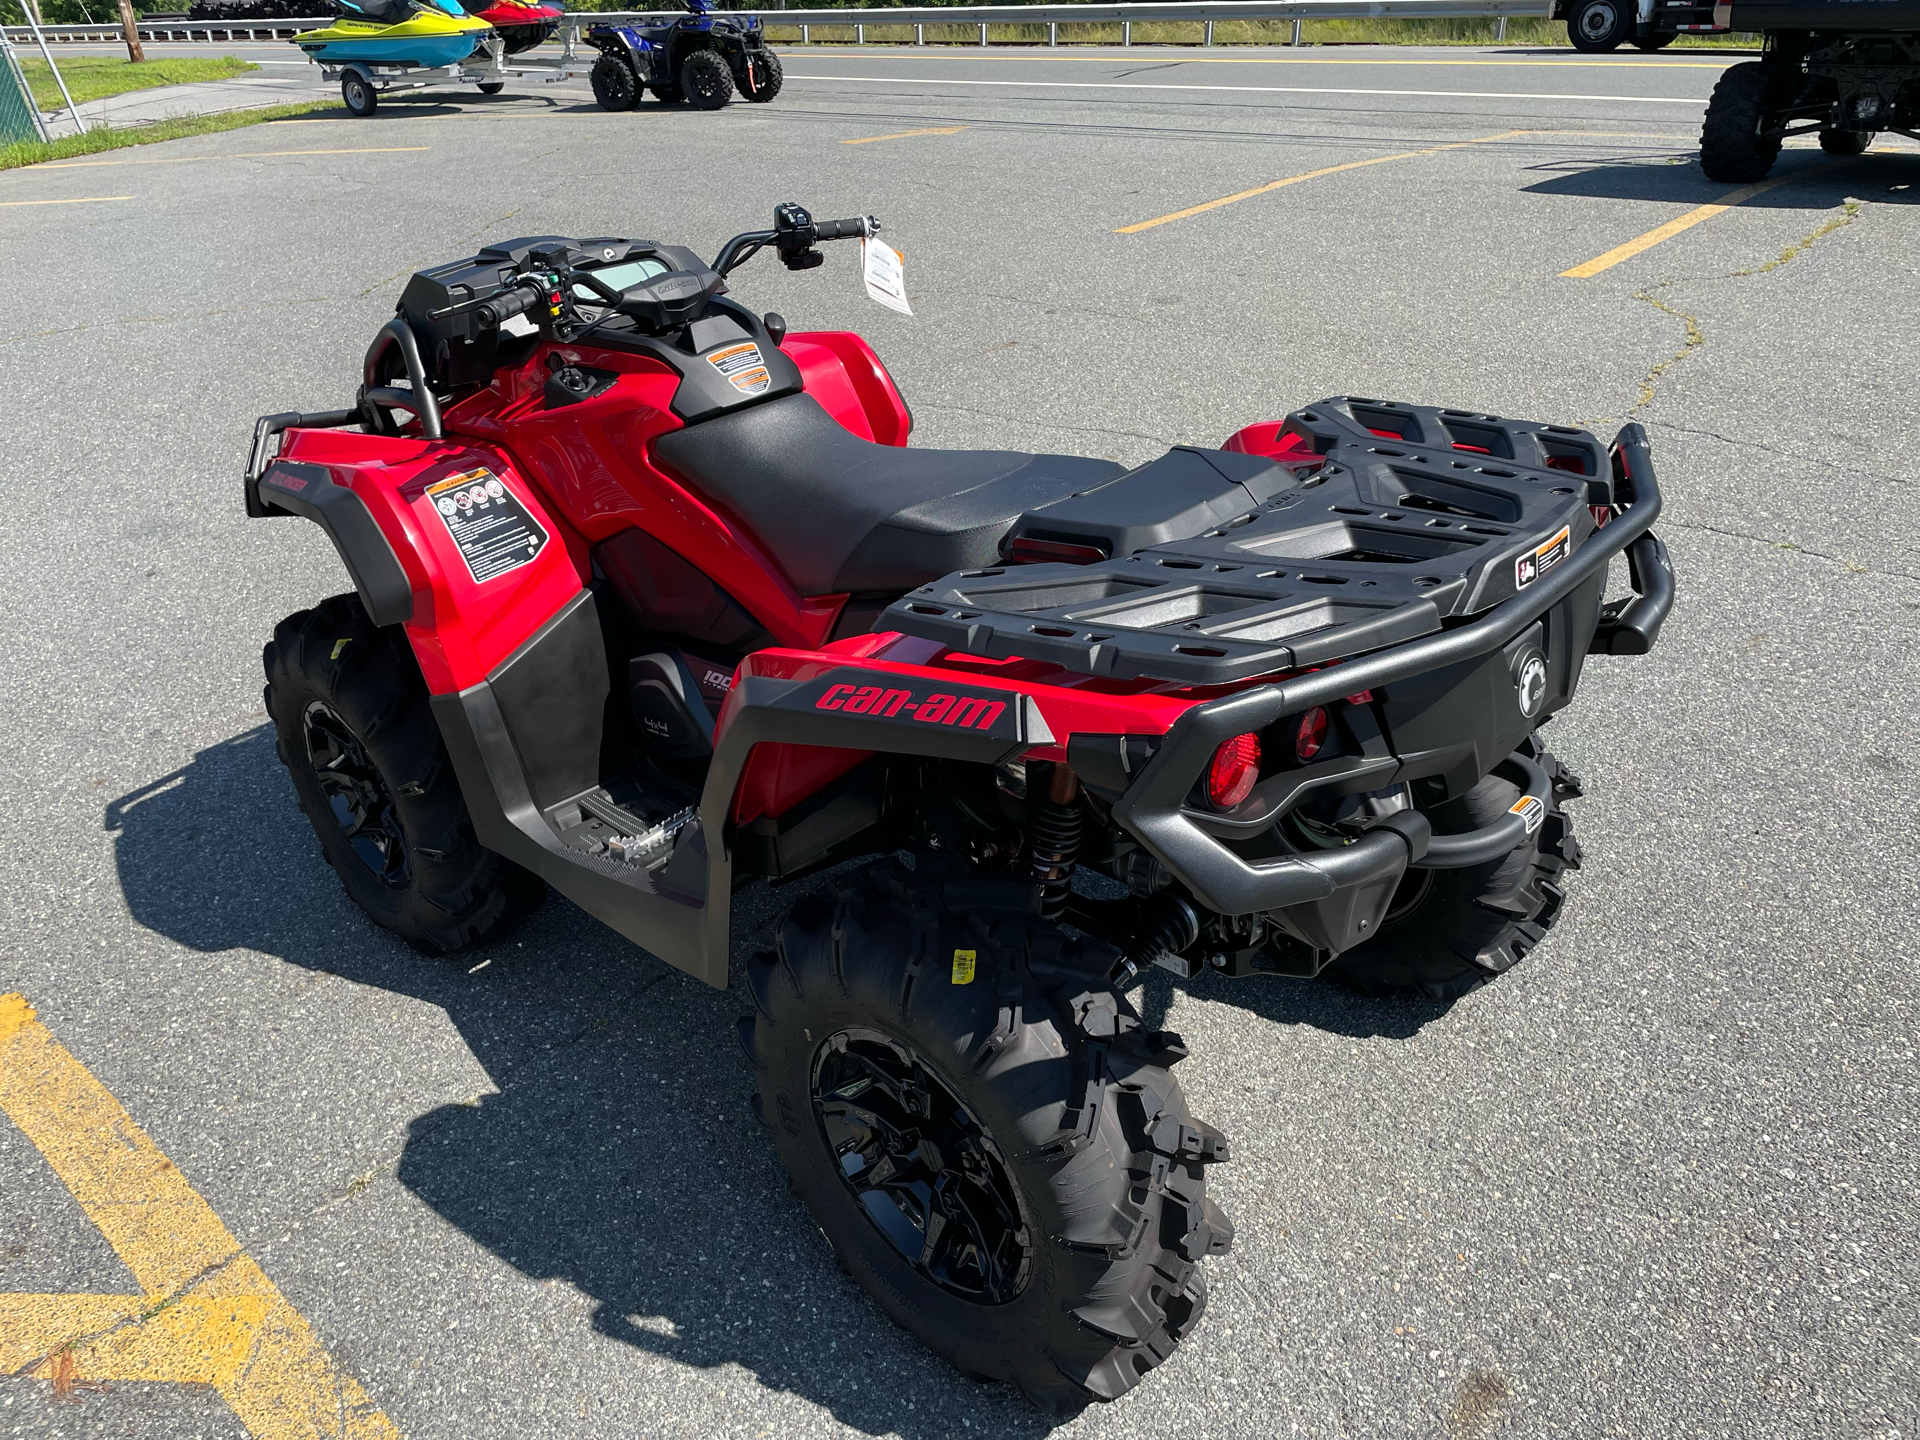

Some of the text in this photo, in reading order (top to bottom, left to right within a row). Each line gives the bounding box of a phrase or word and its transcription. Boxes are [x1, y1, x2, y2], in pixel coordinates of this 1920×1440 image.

[644, 716, 669, 732] 4x4
[815, 683, 1006, 731] can-am
[776, 1092, 801, 1139] ITP
